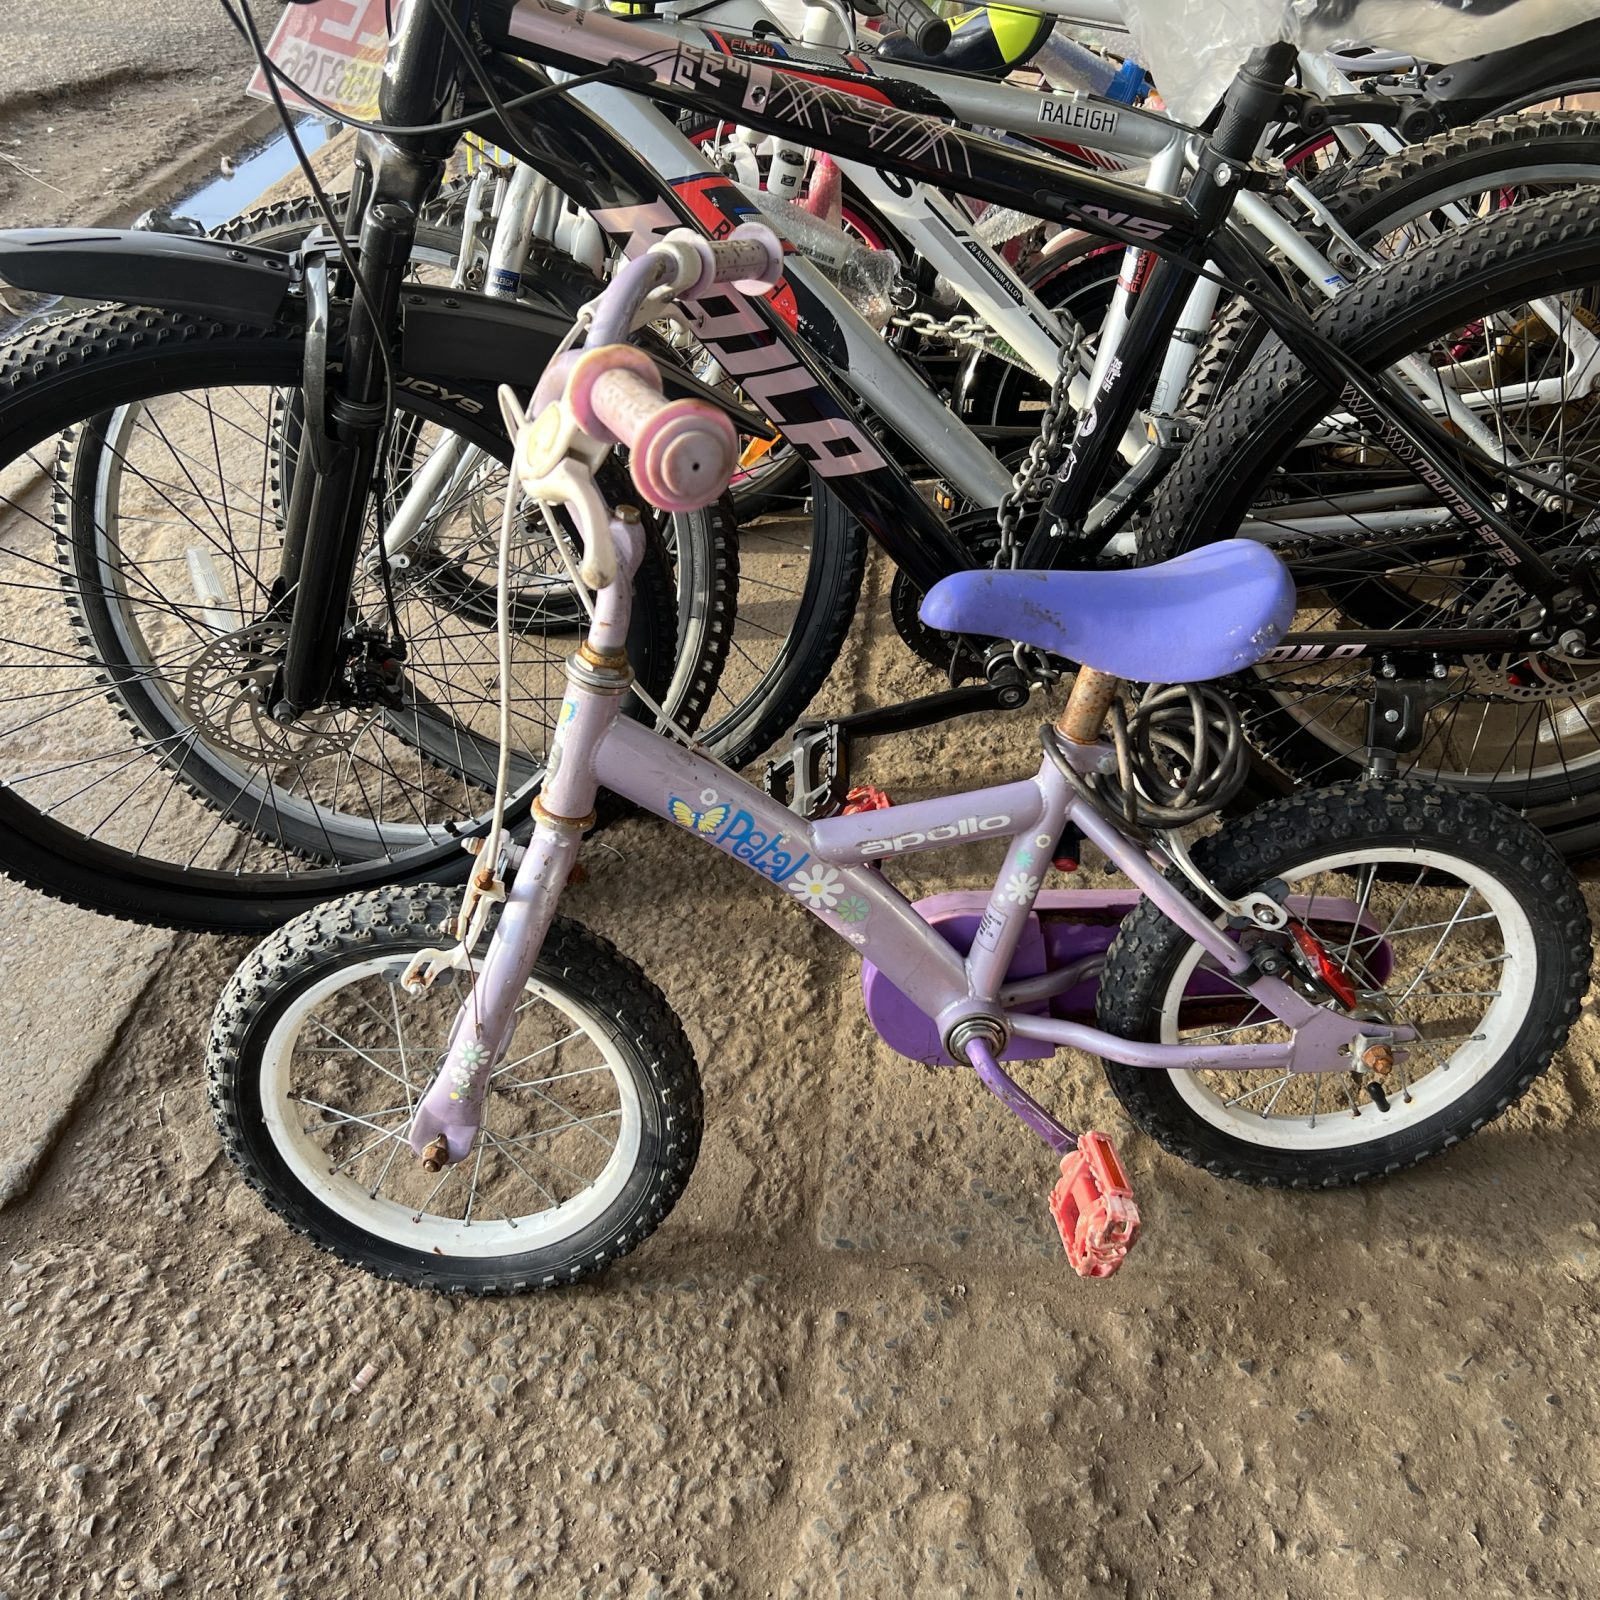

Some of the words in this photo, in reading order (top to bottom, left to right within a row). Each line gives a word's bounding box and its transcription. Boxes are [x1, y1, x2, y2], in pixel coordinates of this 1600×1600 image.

[731, 38, 775, 57] Firefly
[1041, 101, 1117, 133] RALEIGH
[975, 250, 1006, 284] ALUMINIUM
[1003, 282, 1022, 300] ALLOY
[717, 808, 809, 883] Petal
[860, 814, 1012, 856] apollo
